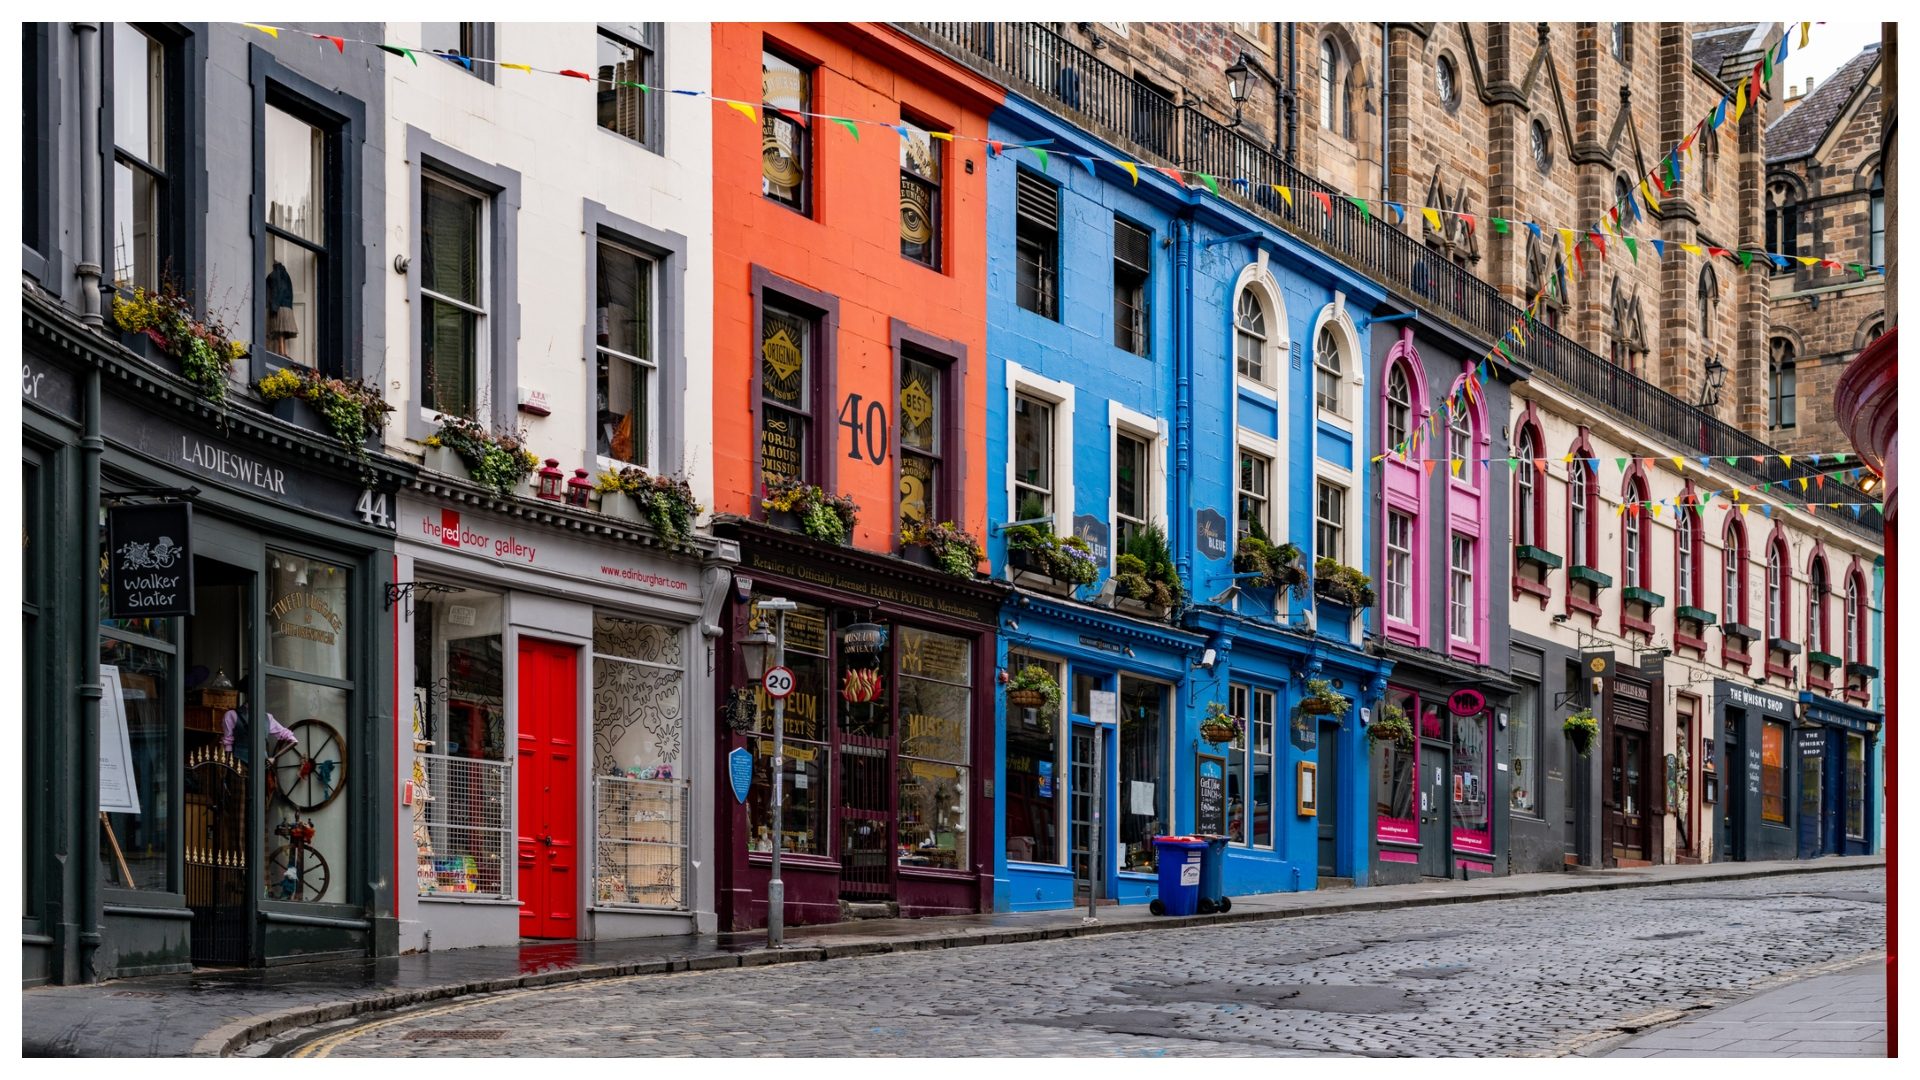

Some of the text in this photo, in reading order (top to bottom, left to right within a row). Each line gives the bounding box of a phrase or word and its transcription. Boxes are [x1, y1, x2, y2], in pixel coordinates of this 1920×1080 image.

[768, 343, 799, 366] ORIGINAL
[906, 394, 927, 413] BEST
[839, 393, 888, 466] 40
[182, 436, 286, 494] LADIESWEAR
[762, 445, 800, 464] AMOUS!
[422, 516, 536, 562] the red door gallery
[1208, 538, 1227, 551] BLEUE
[601, 564, 688, 592] www.edinburghart.com
[753, 554, 785, 573] Retailer
[786, 565, 795, 576] of
[799, 565, 834, 588] Officially
[836, 575, 868, 593] Licensed
[870, 580, 900, 600] HARRY
[901, 590, 935, 609] POTTER
[271, 592, 303, 620] TWEED
[768, 675, 791, 690] 20
[1639, 687, 1648, 699] SON
[755, 685, 817, 722] MUEUM
[1730, 688, 1783, 712] THE WHISKY SHOP
[766, 716, 805, 735] CTEXT
